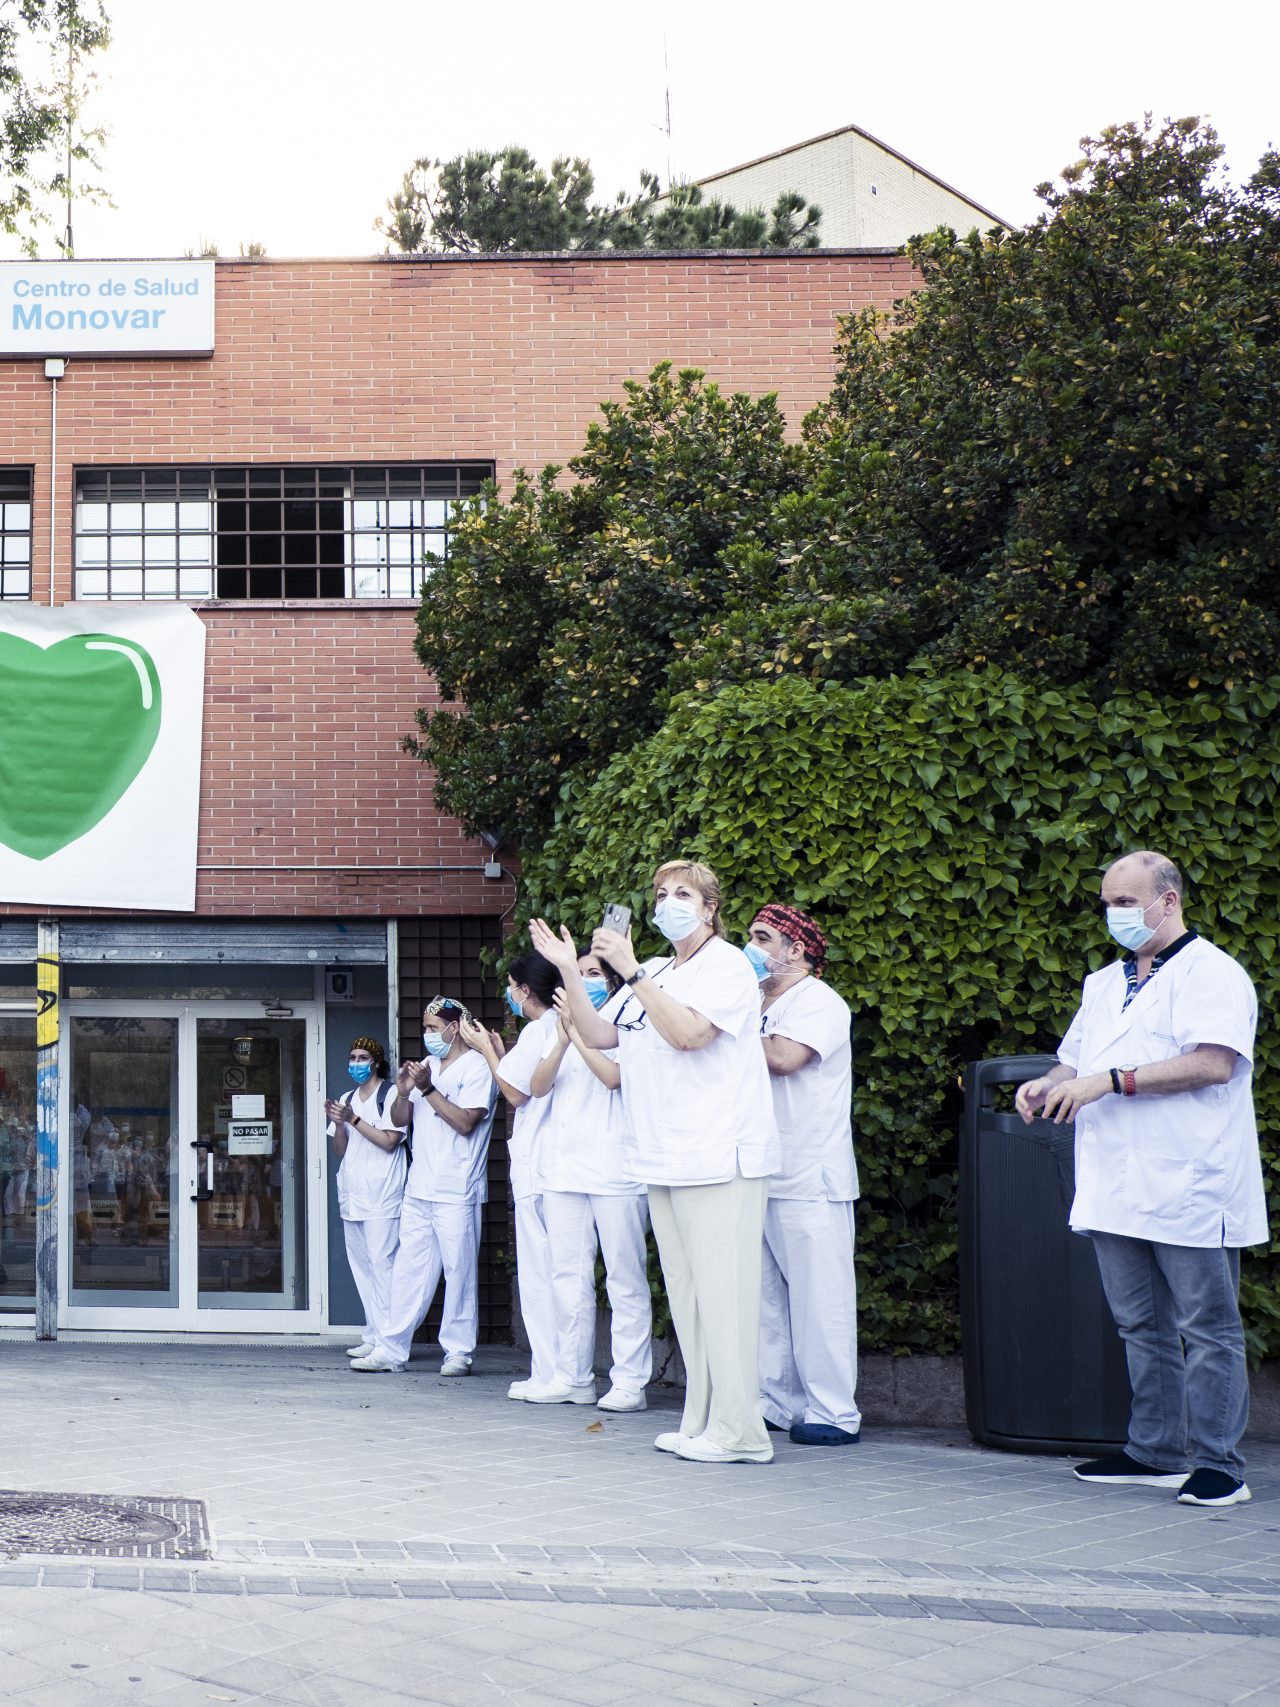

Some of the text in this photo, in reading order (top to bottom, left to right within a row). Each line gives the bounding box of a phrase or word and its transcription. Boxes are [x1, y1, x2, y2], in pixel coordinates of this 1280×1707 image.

[13, 277, 199, 298] Centro de Salud
[12, 303, 165, 331] Monovar
[245, 1127, 268, 1135] PASAR
